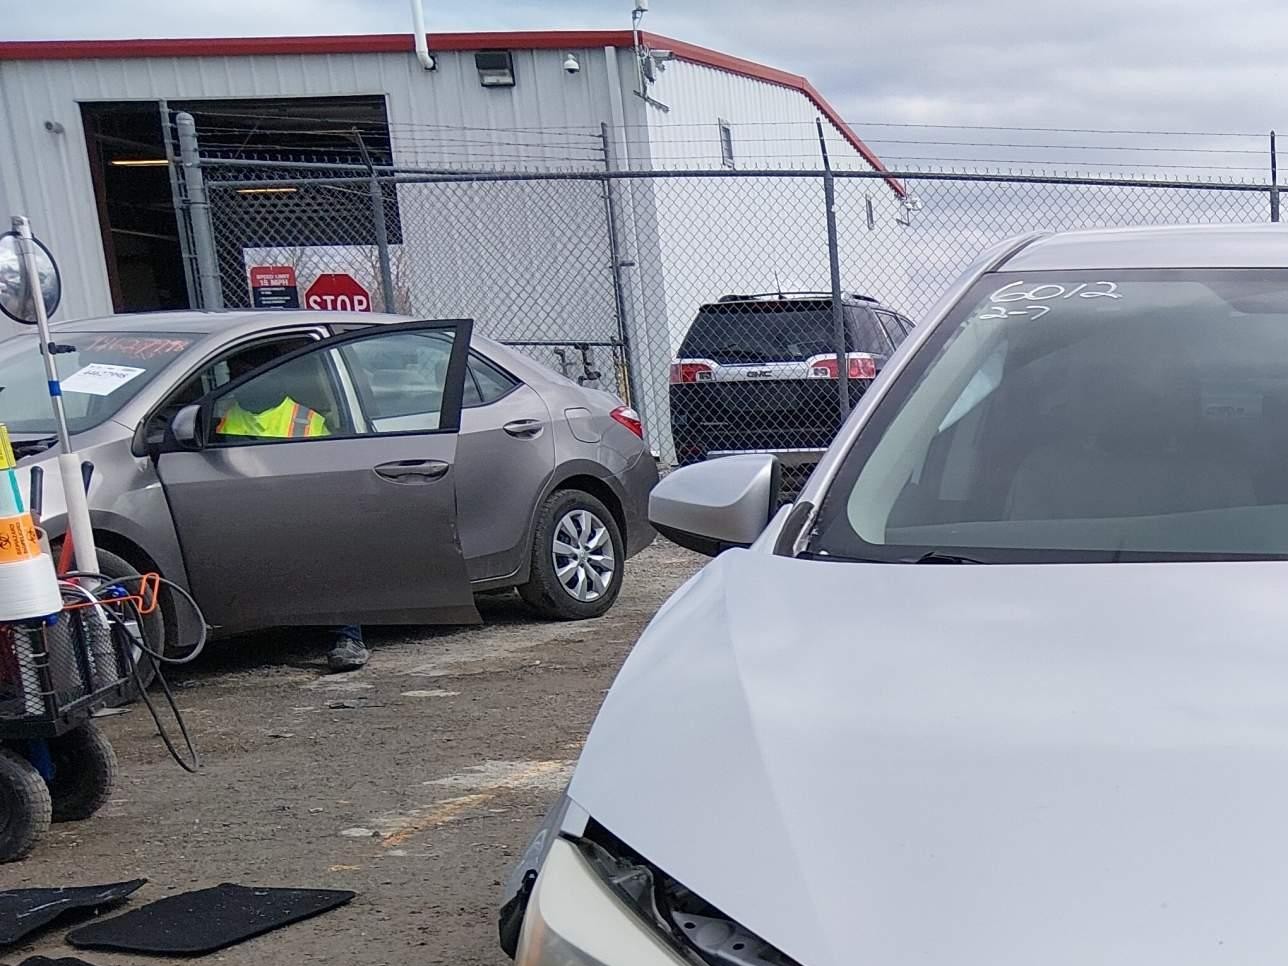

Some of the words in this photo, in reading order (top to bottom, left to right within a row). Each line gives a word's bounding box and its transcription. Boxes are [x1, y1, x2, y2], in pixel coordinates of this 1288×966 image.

[990, 280, 1123, 303] 6012
[309, 295, 368, 312] STOP
[747, 370, 773, 378] GMC
